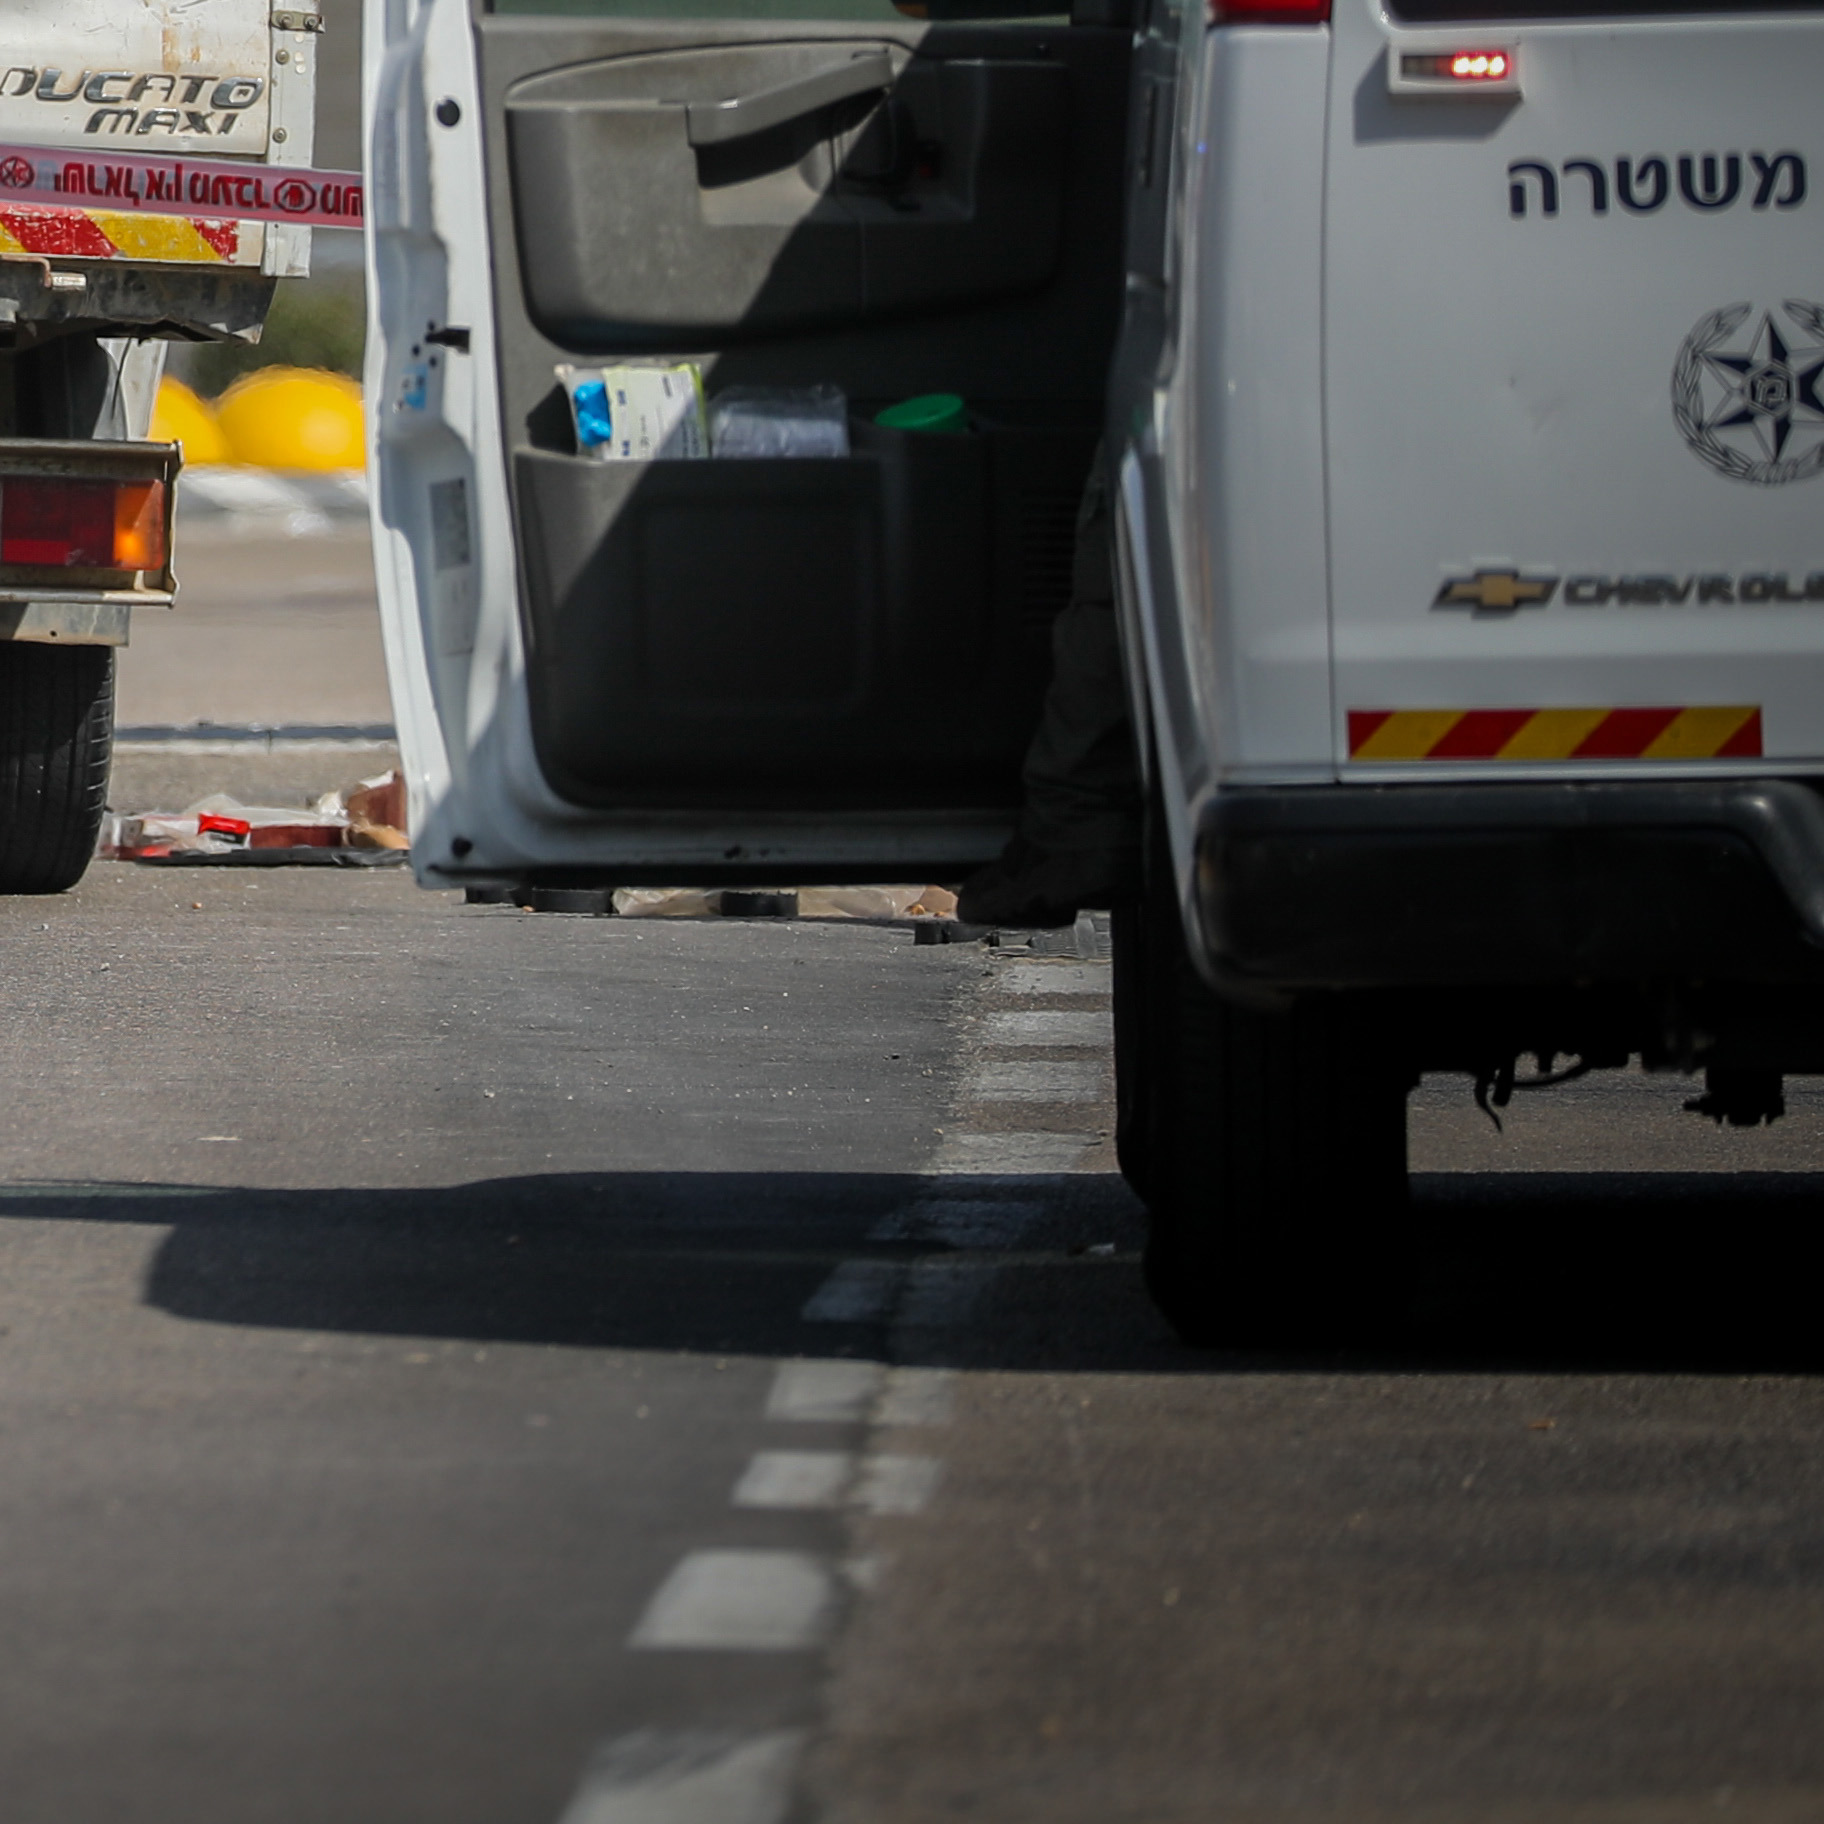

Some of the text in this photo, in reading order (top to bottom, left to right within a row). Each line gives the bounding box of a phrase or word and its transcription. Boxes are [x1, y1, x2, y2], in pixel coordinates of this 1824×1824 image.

[84, 107, 239, 135] MAXI
[54, 162, 140, 207] ישראל
[145, 163, 183, 203] אין
[189, 172, 271, 209] מעבר
[1508, 152, 1807, 217] משטרה
